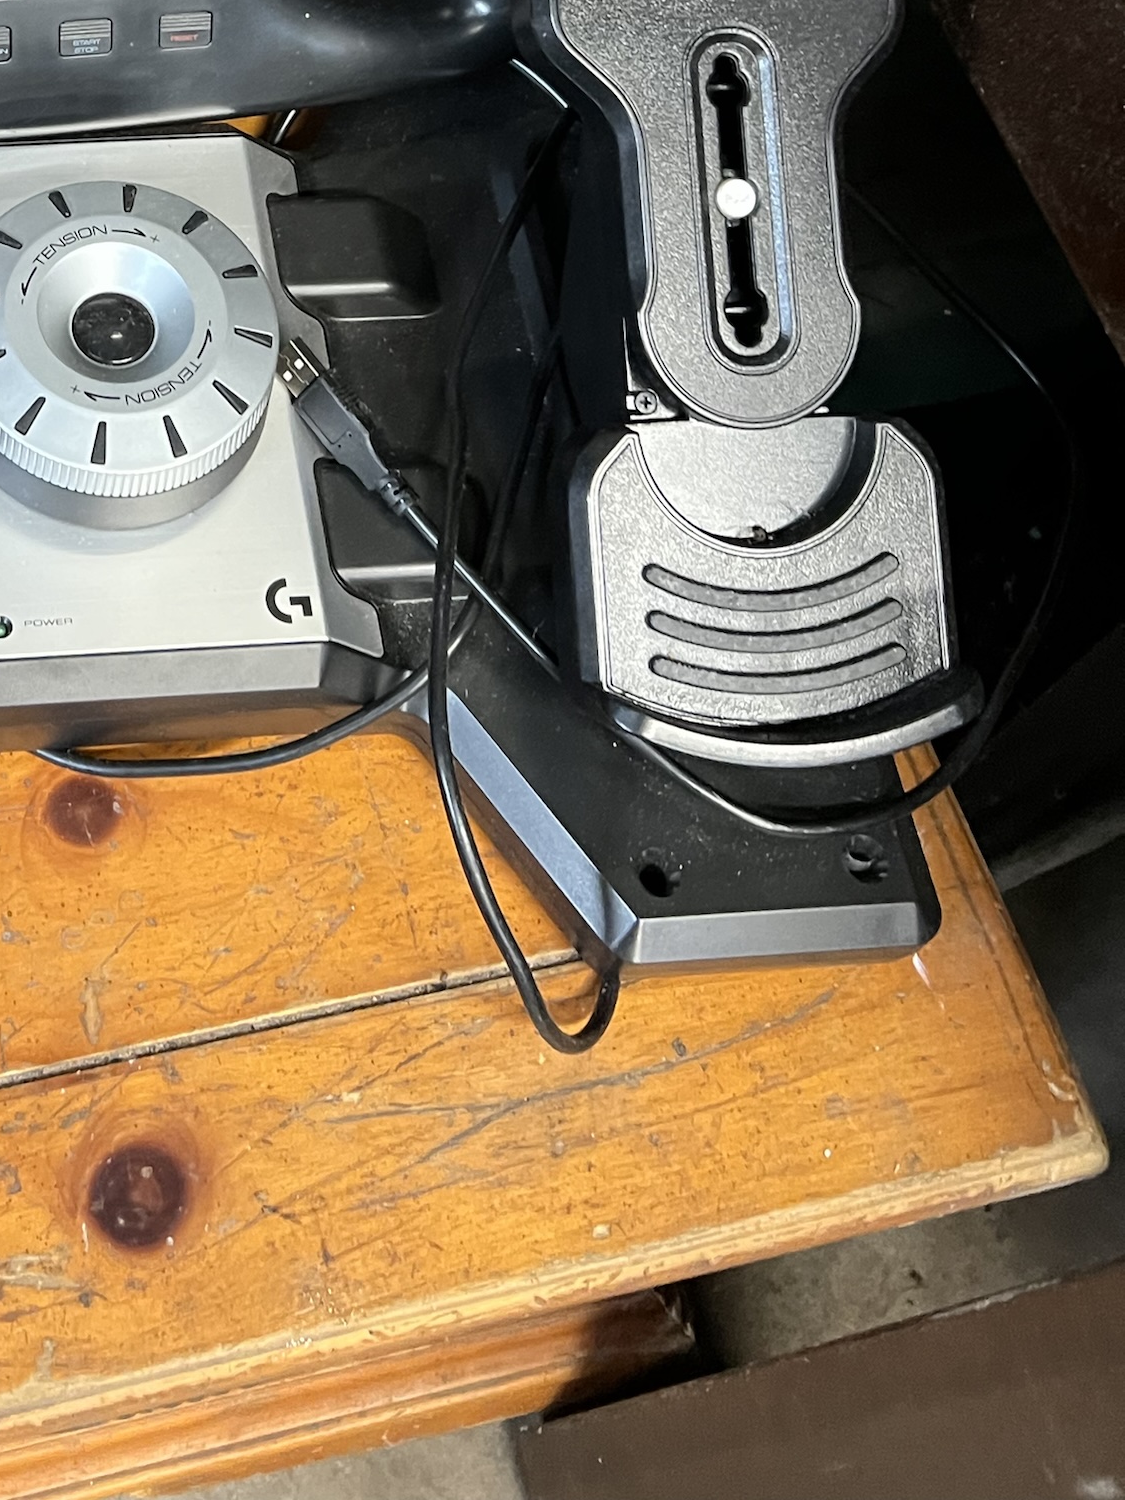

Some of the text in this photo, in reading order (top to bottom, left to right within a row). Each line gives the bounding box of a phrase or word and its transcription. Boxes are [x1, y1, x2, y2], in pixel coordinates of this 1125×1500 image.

[32, 224, 108, 266] TENSION
[124, 361, 203, 406] TENSION
[23, 617, 74, 628] POWER
